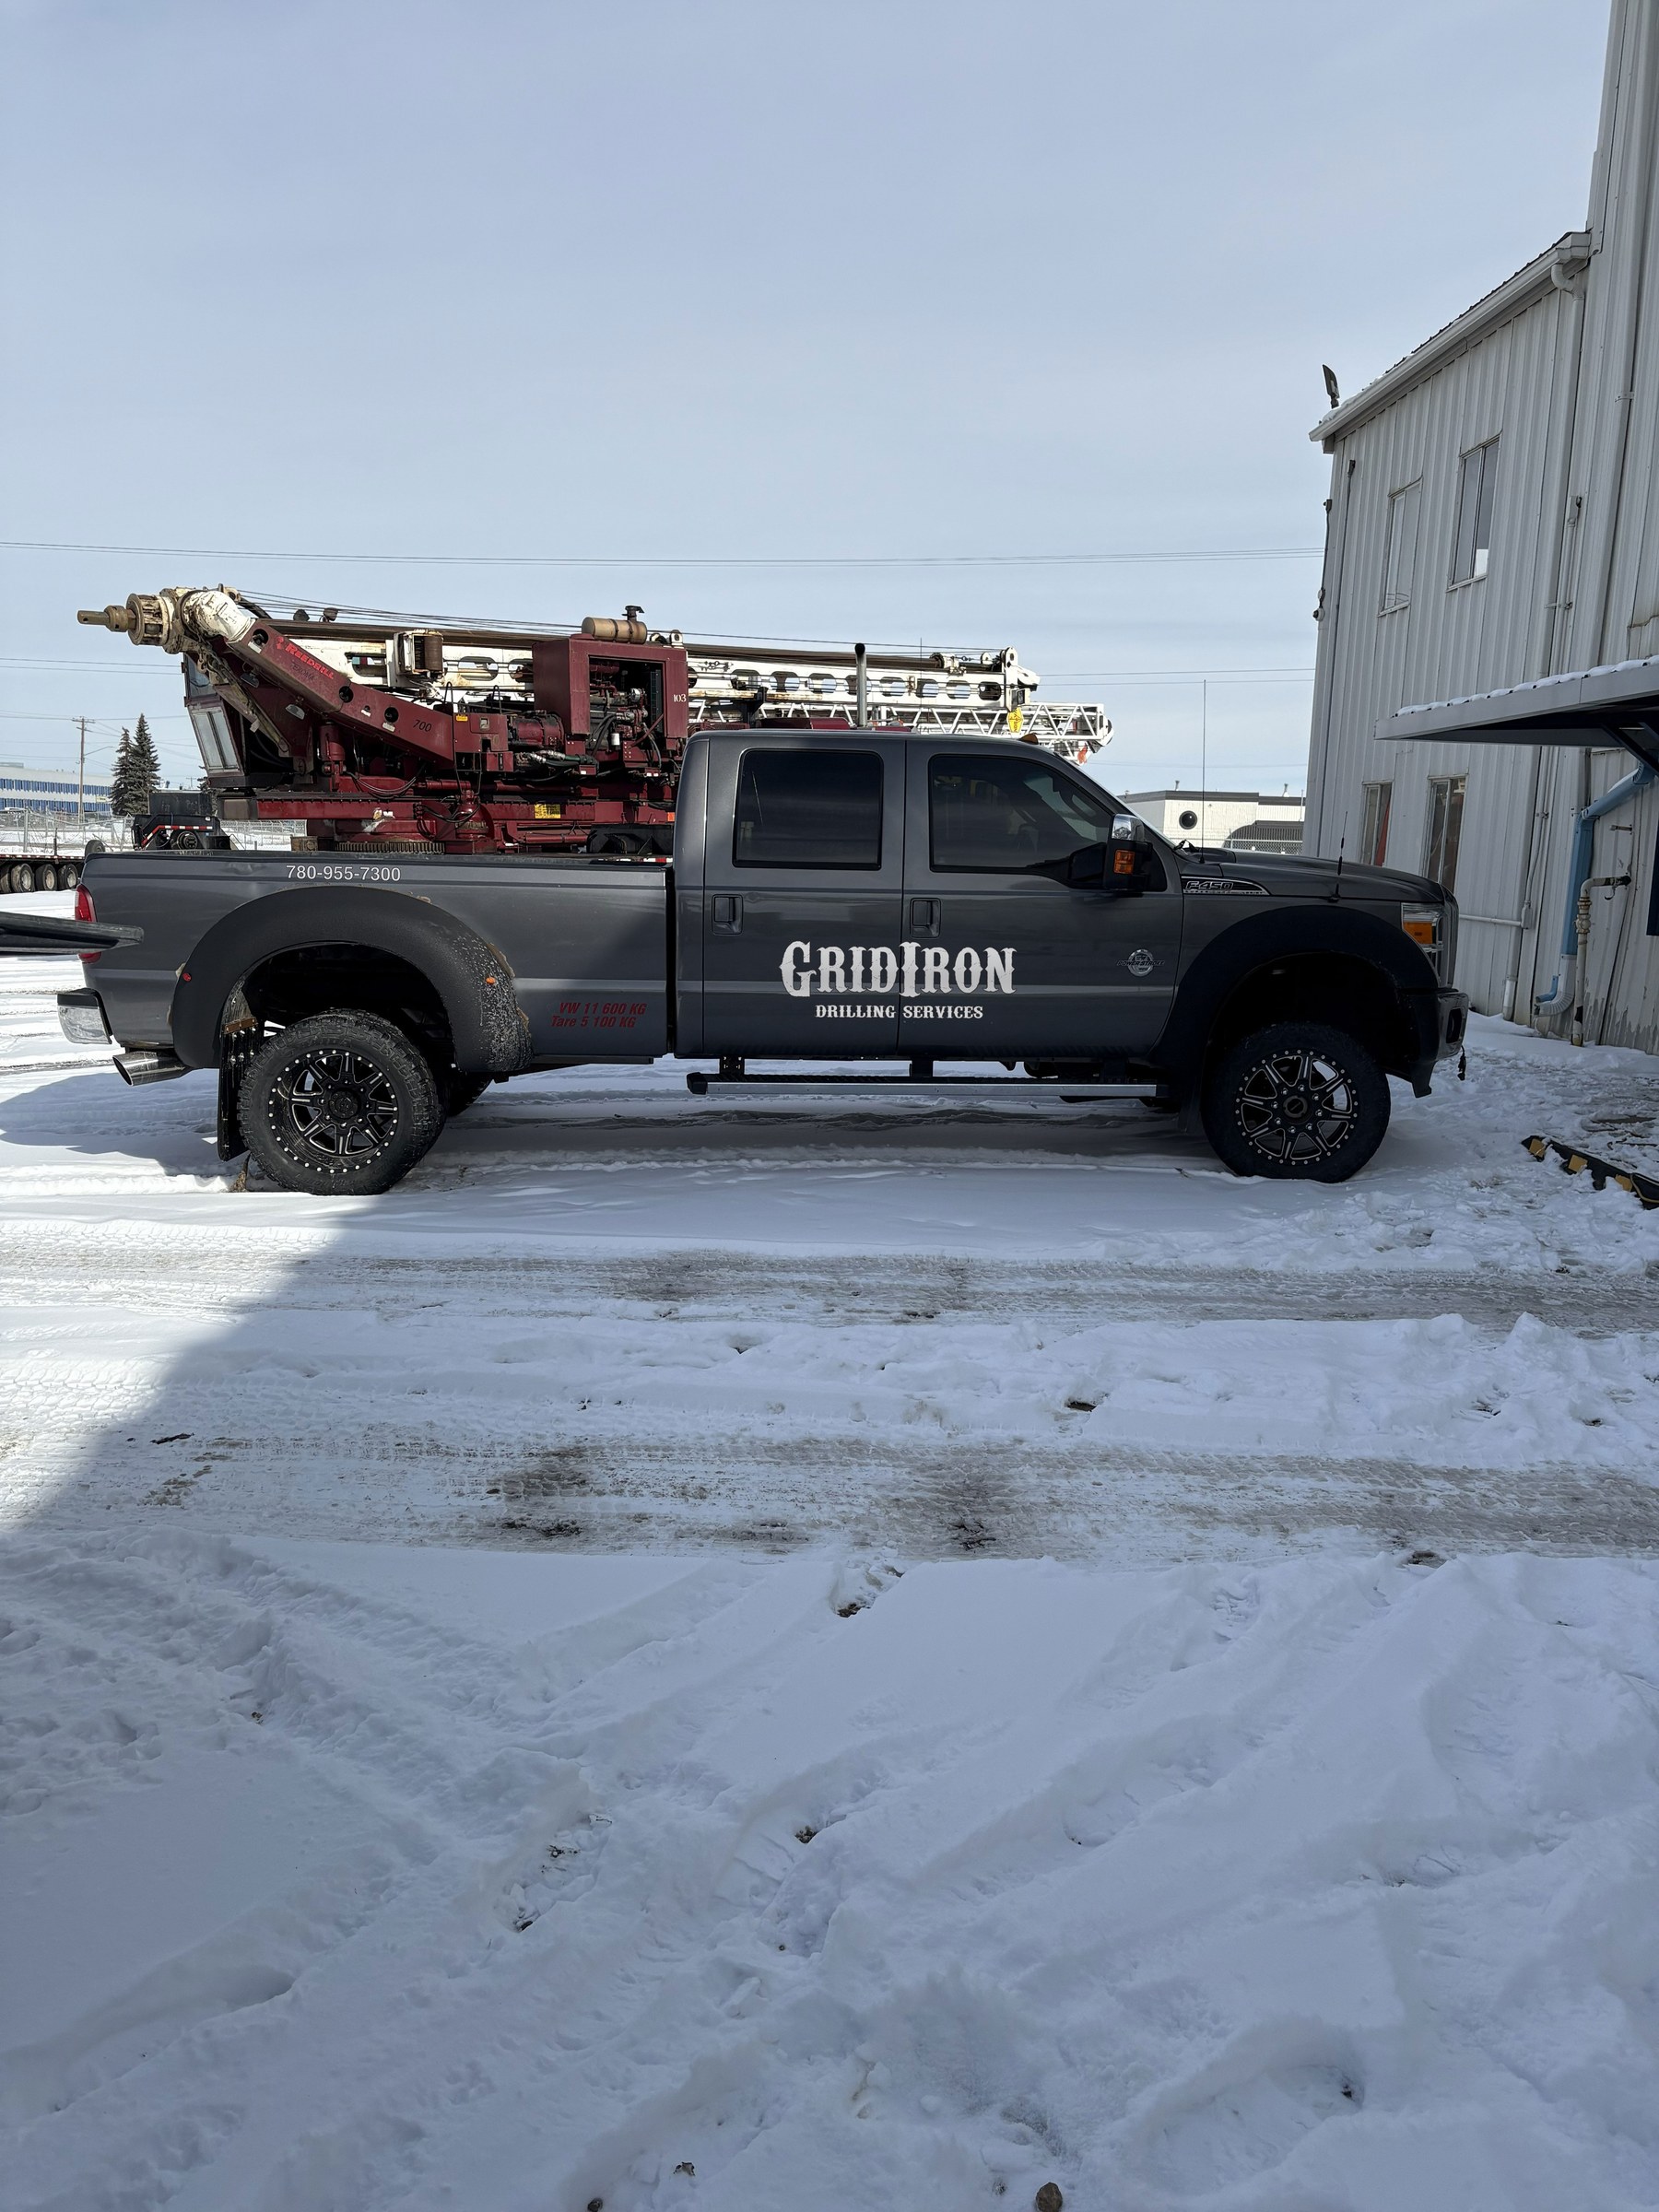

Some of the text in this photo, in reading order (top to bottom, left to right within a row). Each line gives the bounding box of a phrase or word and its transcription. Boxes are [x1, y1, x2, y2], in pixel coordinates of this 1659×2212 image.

[286, 642, 334, 679] REEDRILL
[673, 693, 686, 702] 103
[413, 719, 432, 732] 700
[286, 865, 401, 881] 780-955-7300
[602, 1002, 627, 1015] 600
[629, 1003, 648, 1016] KG
[816, 1005, 983, 1018] DRILLING SERVICES
[552, 1015, 637, 1028] Tare 5 100 KG
